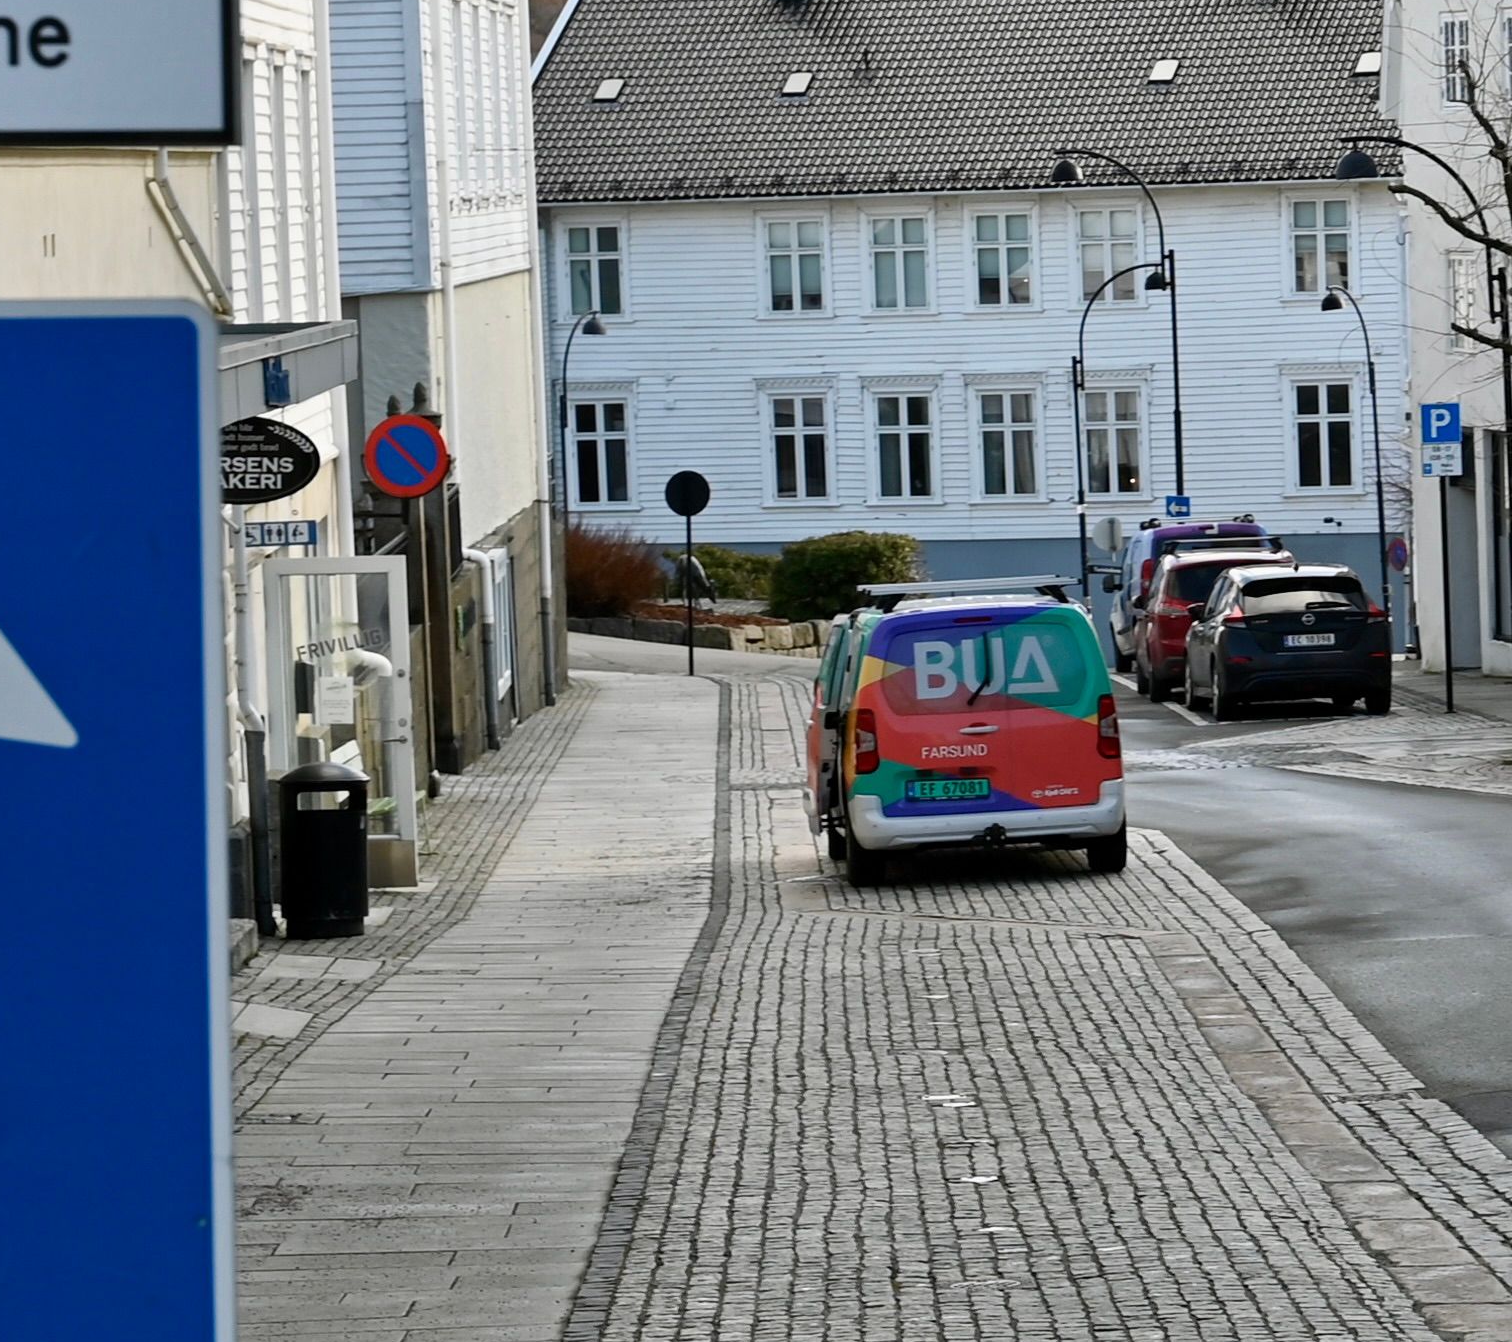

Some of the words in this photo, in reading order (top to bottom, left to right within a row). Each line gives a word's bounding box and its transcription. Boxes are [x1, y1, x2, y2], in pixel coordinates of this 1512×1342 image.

[1430, 408, 1451, 438] P
[219, 456, 294, 473] RSENS
[219, 474, 282, 489] AKERI
[296, 629, 382, 661] FRIVILLIG
[913, 635, 1060, 700] BUA
[921, 743, 988, 759] FARSUND
[919, 782, 935, 796] EF
[942, 780, 985, 795] 67081
